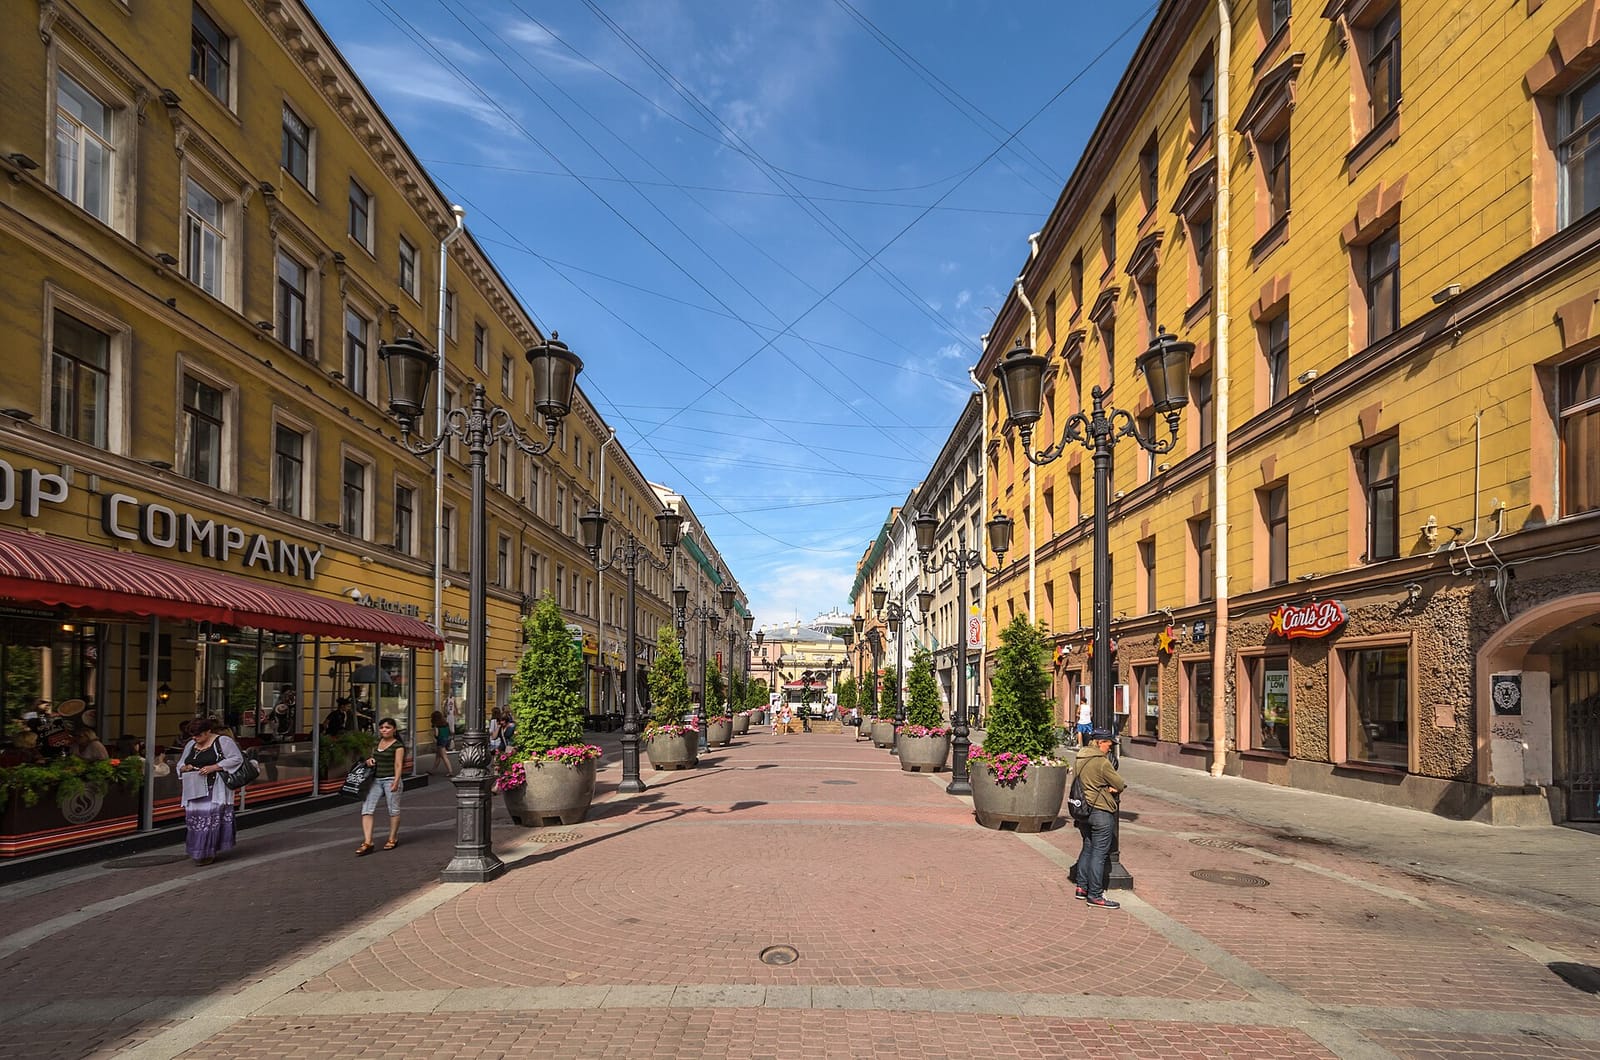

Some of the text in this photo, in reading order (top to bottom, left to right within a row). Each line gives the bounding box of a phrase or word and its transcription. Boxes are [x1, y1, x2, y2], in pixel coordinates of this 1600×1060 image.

[103, 493, 322, 581] COMPANY
[1282, 603, 1341, 630] Carl's Jr.
[1270, 681, 1284, 689] LOW
